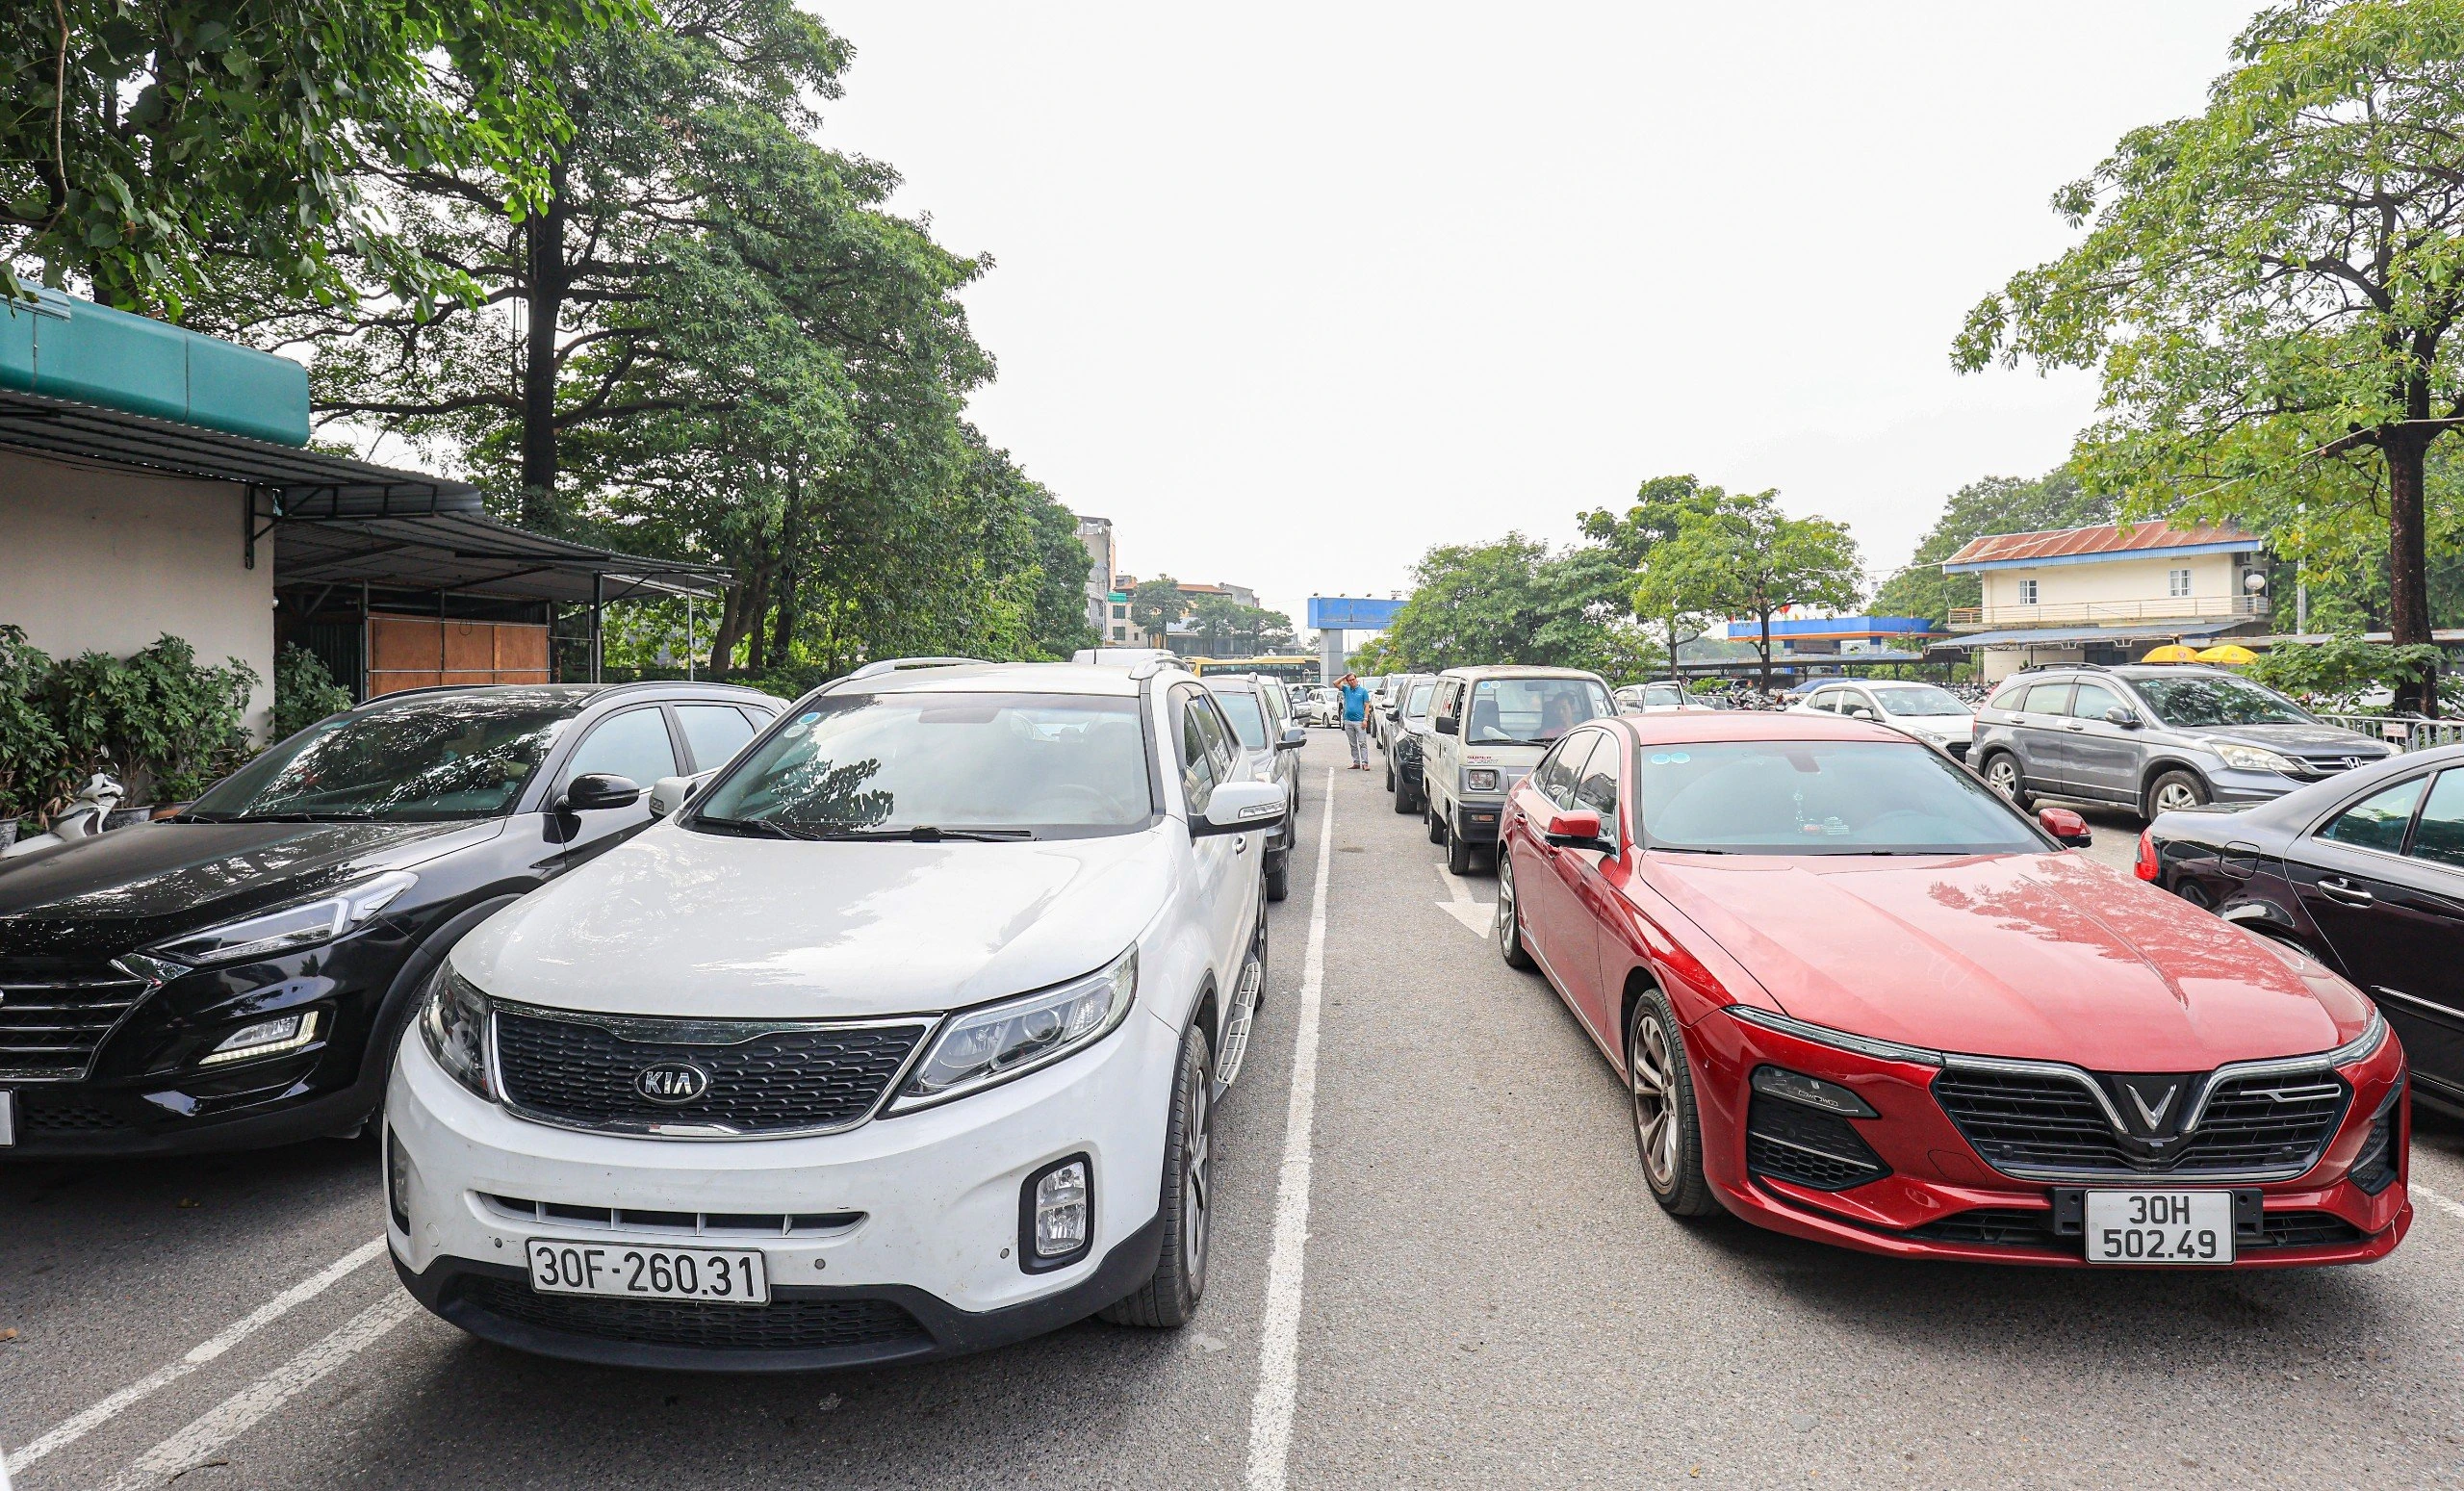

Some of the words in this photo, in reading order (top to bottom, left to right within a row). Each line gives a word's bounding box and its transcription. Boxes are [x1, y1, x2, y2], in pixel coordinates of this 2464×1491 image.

[645, 1070, 693, 1094] KIA
[2129, 1195, 2190, 1224] 30H
[2103, 1229, 2217, 1258] 502.49
[536, 1247, 754, 1298] 30F-260.31
